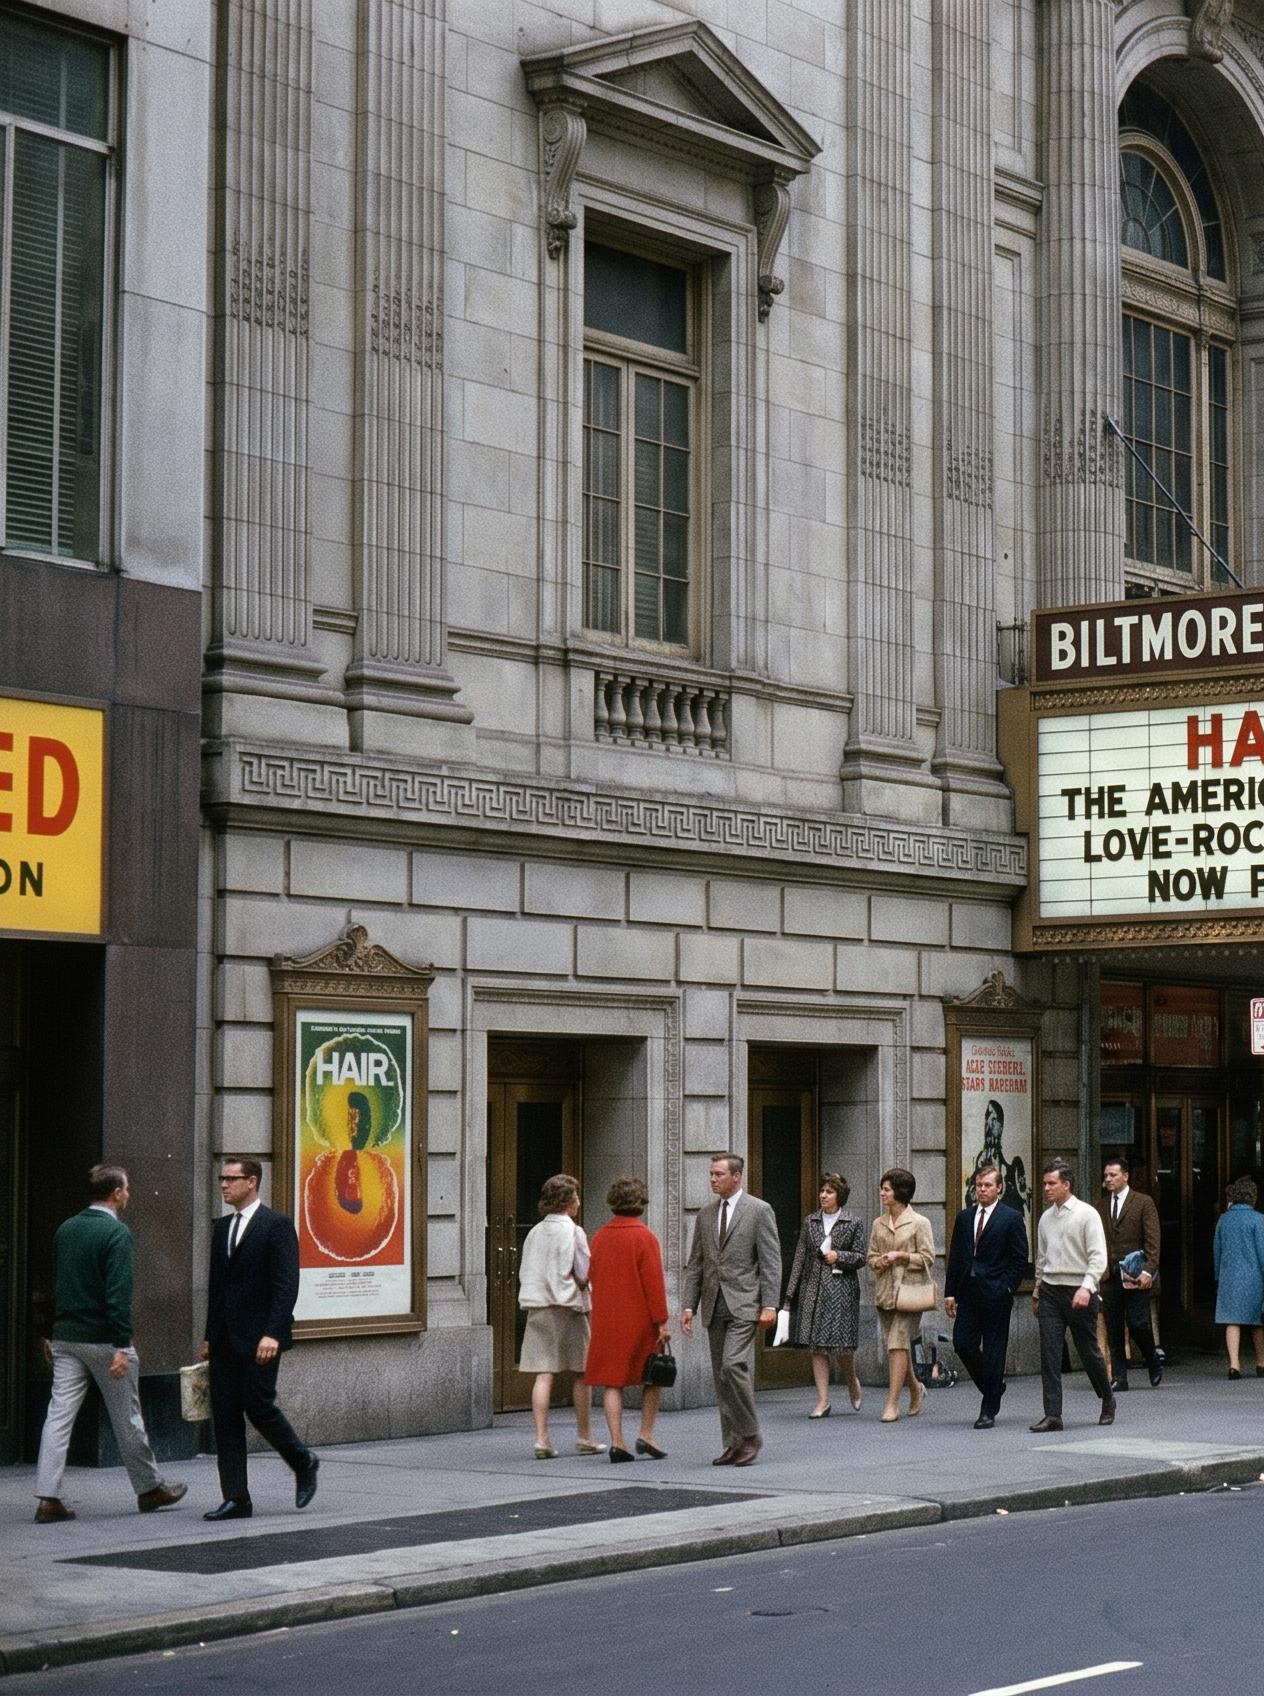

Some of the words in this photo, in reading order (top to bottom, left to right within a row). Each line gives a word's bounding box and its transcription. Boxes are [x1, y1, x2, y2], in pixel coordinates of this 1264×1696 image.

[1050, 603, 1264, 671] BILTMORE
[1060, 784, 1127, 821] THE
[1147, 866, 1229, 903] NOW
